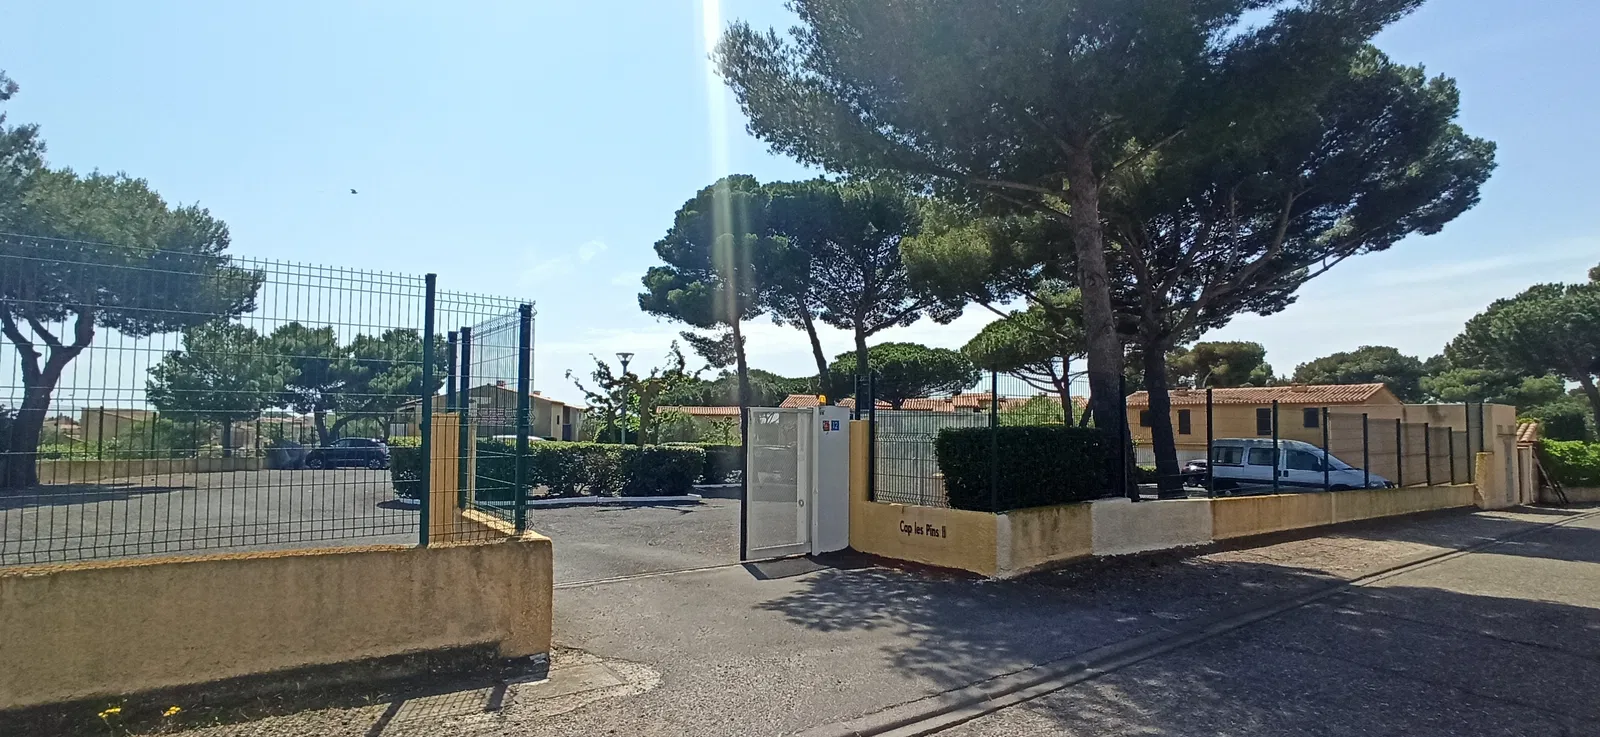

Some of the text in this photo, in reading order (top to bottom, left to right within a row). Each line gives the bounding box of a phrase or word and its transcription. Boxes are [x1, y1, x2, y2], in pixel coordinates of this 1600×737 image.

[899, 520, 913, 536] Cap
[914, 521, 924, 535] les
[925, 523, 940, 538] Pins
